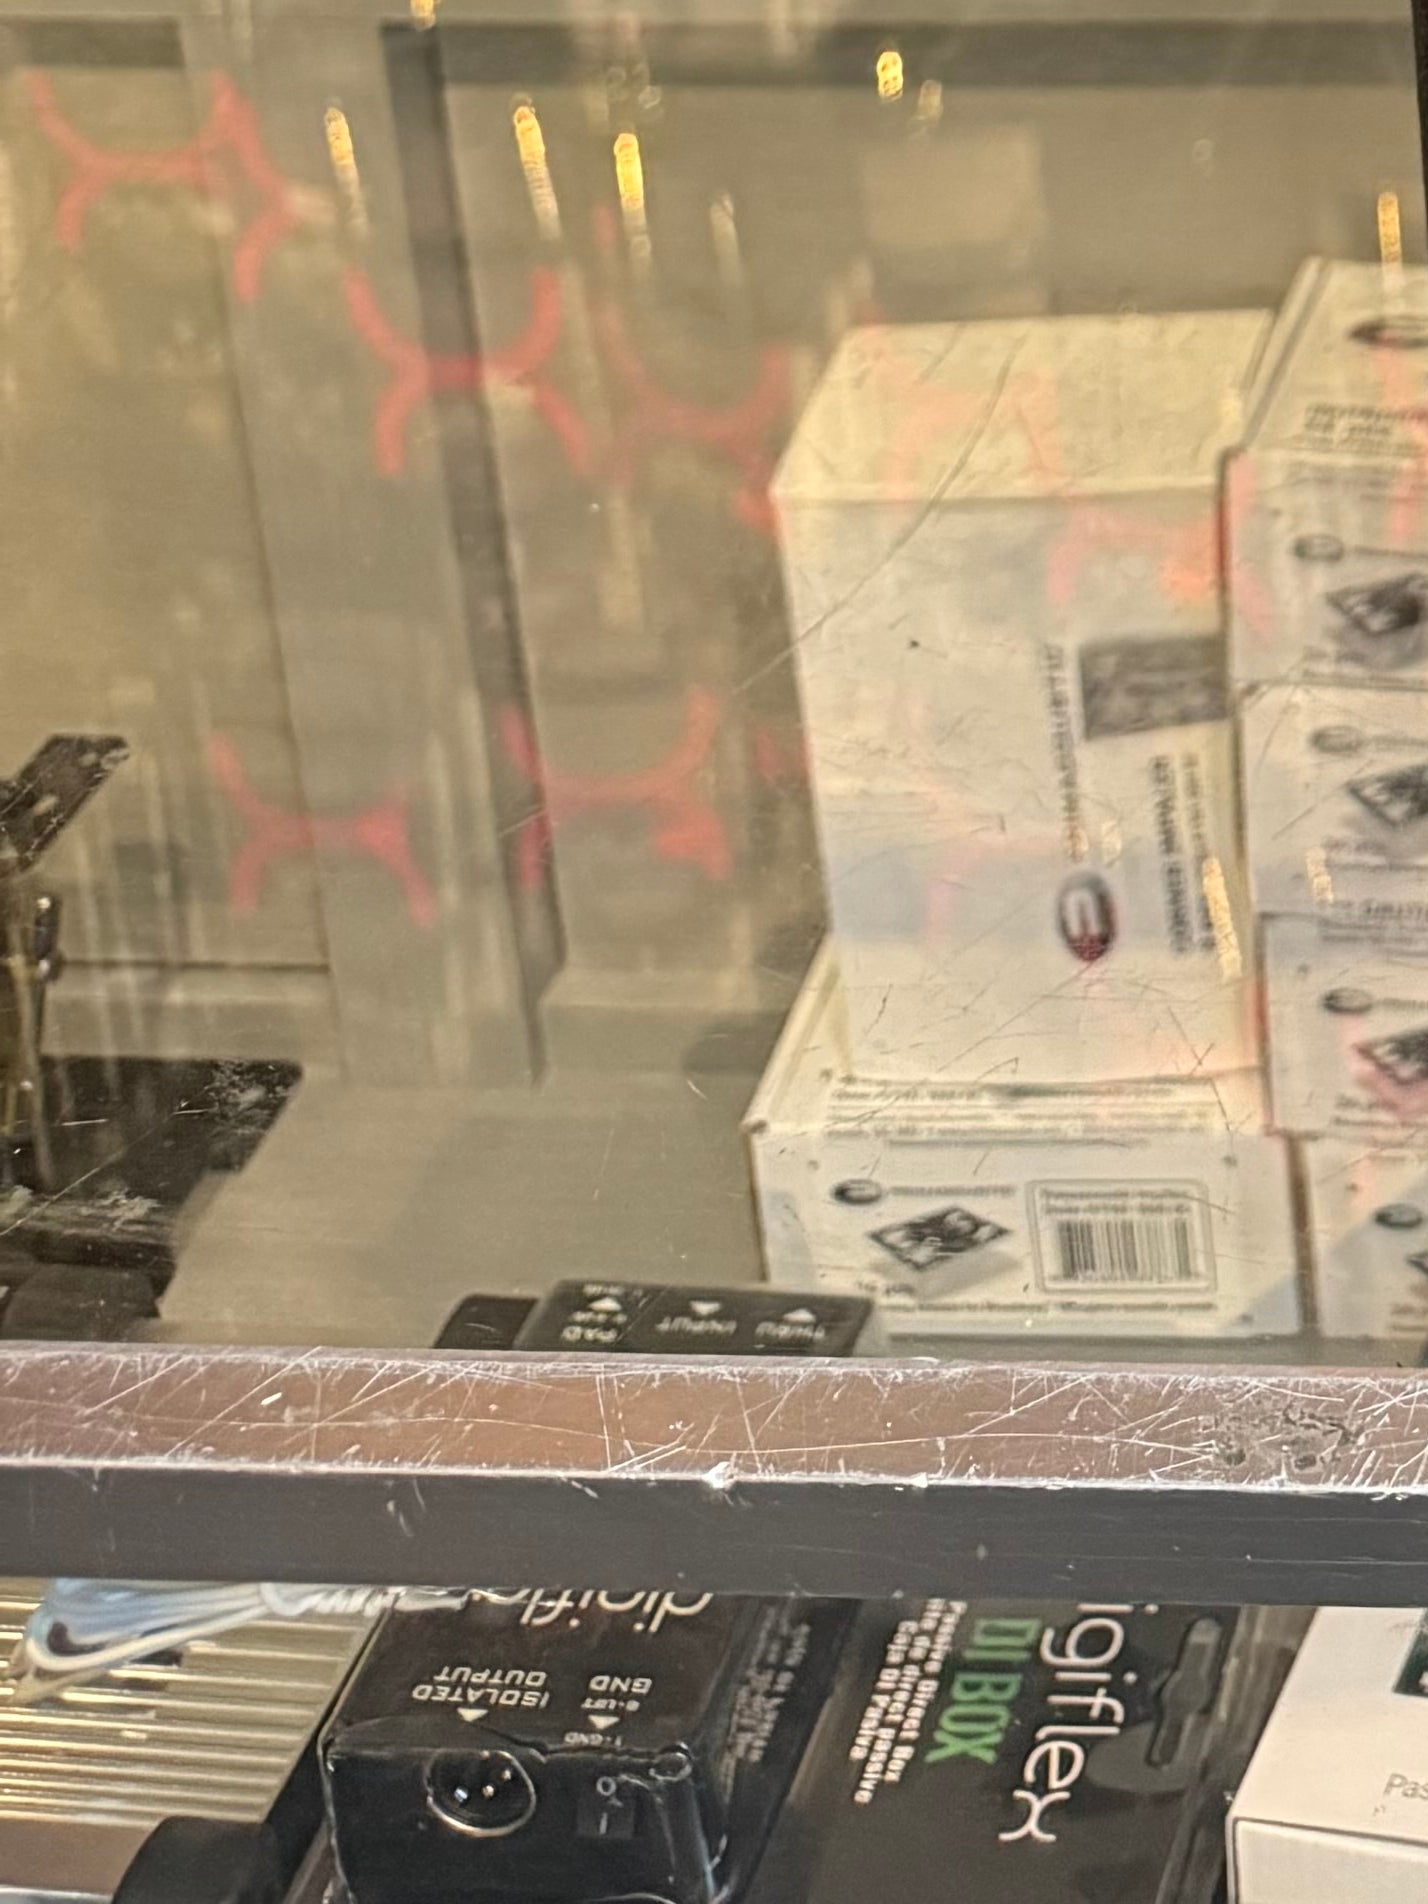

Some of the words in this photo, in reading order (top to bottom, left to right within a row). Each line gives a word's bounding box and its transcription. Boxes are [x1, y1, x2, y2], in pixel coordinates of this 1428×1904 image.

[961, 1618, 1042, 1661] DI
[433, 1666, 547, 1687] OUTPUT
[589, 1675, 652, 1694] GND
[412, 1684, 550, 1709] ISOLATED
[925, 1672, 1026, 1765] BOX
